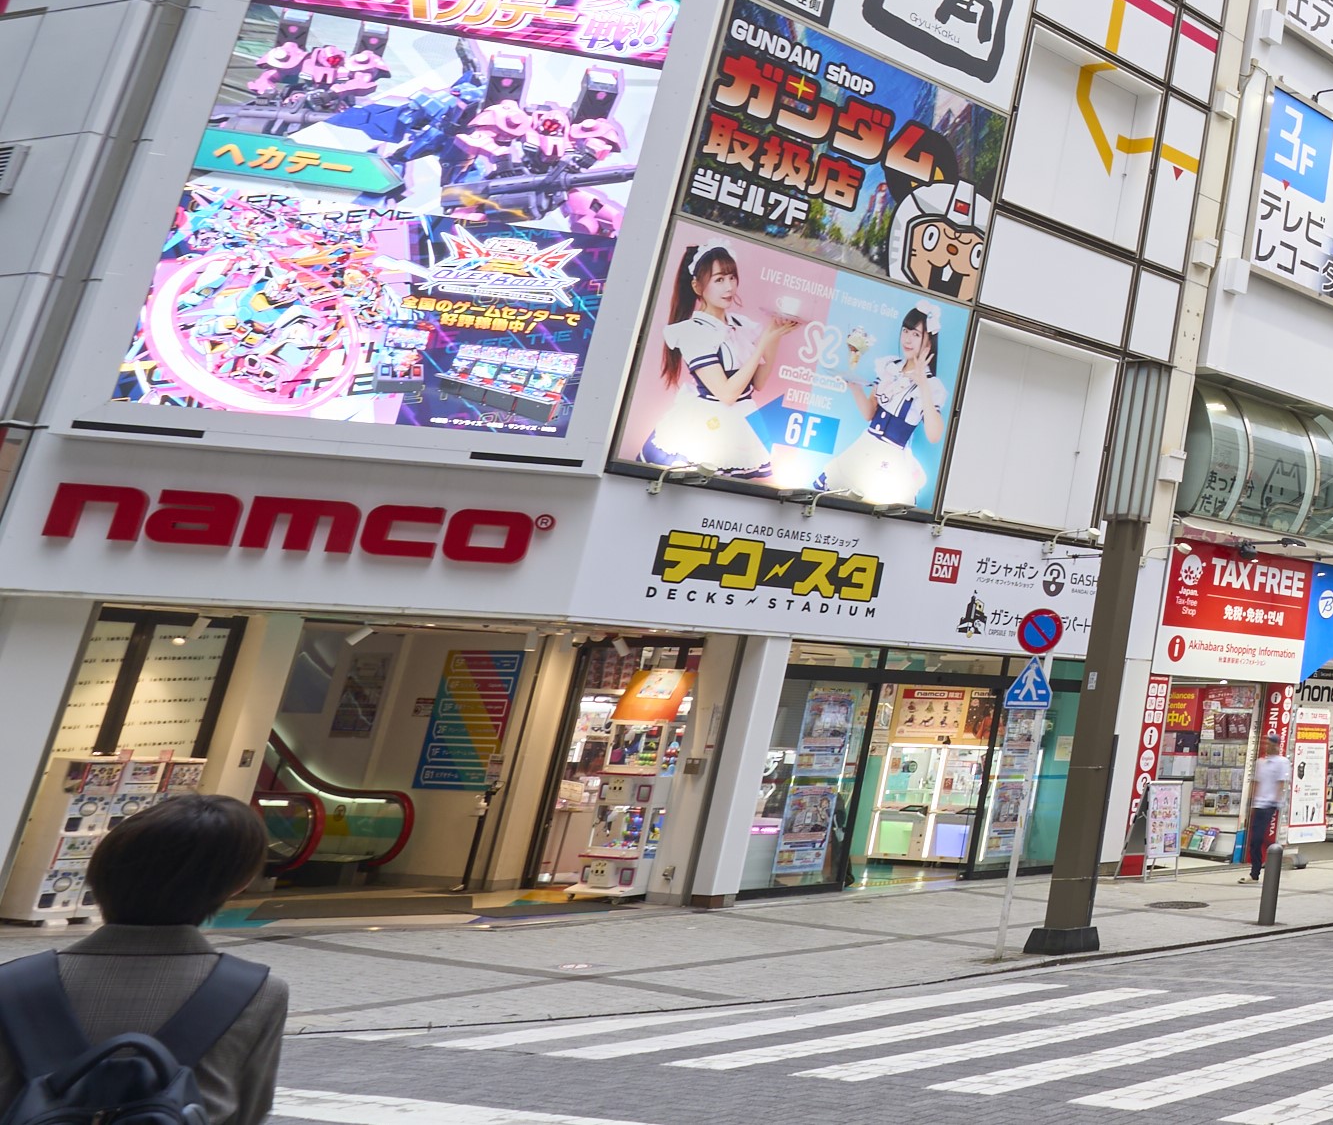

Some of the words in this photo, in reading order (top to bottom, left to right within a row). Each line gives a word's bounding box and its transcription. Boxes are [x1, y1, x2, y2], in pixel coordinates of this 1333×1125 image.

[730, 19, 821, 74] GUNDAM
[825, 64, 875, 96] shop
[714, 53, 938, 183] ガンダム
[1274, 101, 1317, 176] 3F
[213, 142, 354, 176] ヘカテー
[702, 113, 867, 211] 取扱店
[690, 166, 812, 227] 当ビル7F
[1260, 187, 1326, 249] テレビ
[760, 266, 783, 285] LIVE
[783, 271, 841, 302] RESTAURANT
[400, 295, 581, 326] 全国のゲームセンターで
[778, 364, 847, 394] maidreamin
[786, 388, 833, 411] ENTRANCE
[784, 413, 822, 449] 6F
[44, 479, 535, 564] namco
[701, 517, 743, 534] BANDAI
[745, 521, 775, 538] CARD
[776, 525, 812, 543] GAMES
[814, 531, 861, 549] 公式ショップ
[932, 565, 953, 579] DAI
[934, 552, 960, 567] BAN
[976, 556, 1040, 580] ガシャポン
[1212, 557, 1253, 590] TAX
[1252, 564, 1306, 598] FREE
[646, 586, 735, 608] DECKS
[767, 596, 877, 620] STADIUM
[1175, 596, 1197, 608] Tax-free
[1181, 606, 1197, 617] Shop
[1188, 639, 1224, 654] Akihabara
[1225, 643, 1257, 657] Shopping
[1257, 645, 1296, 660] Information
[914, 690, 947, 698] namco
